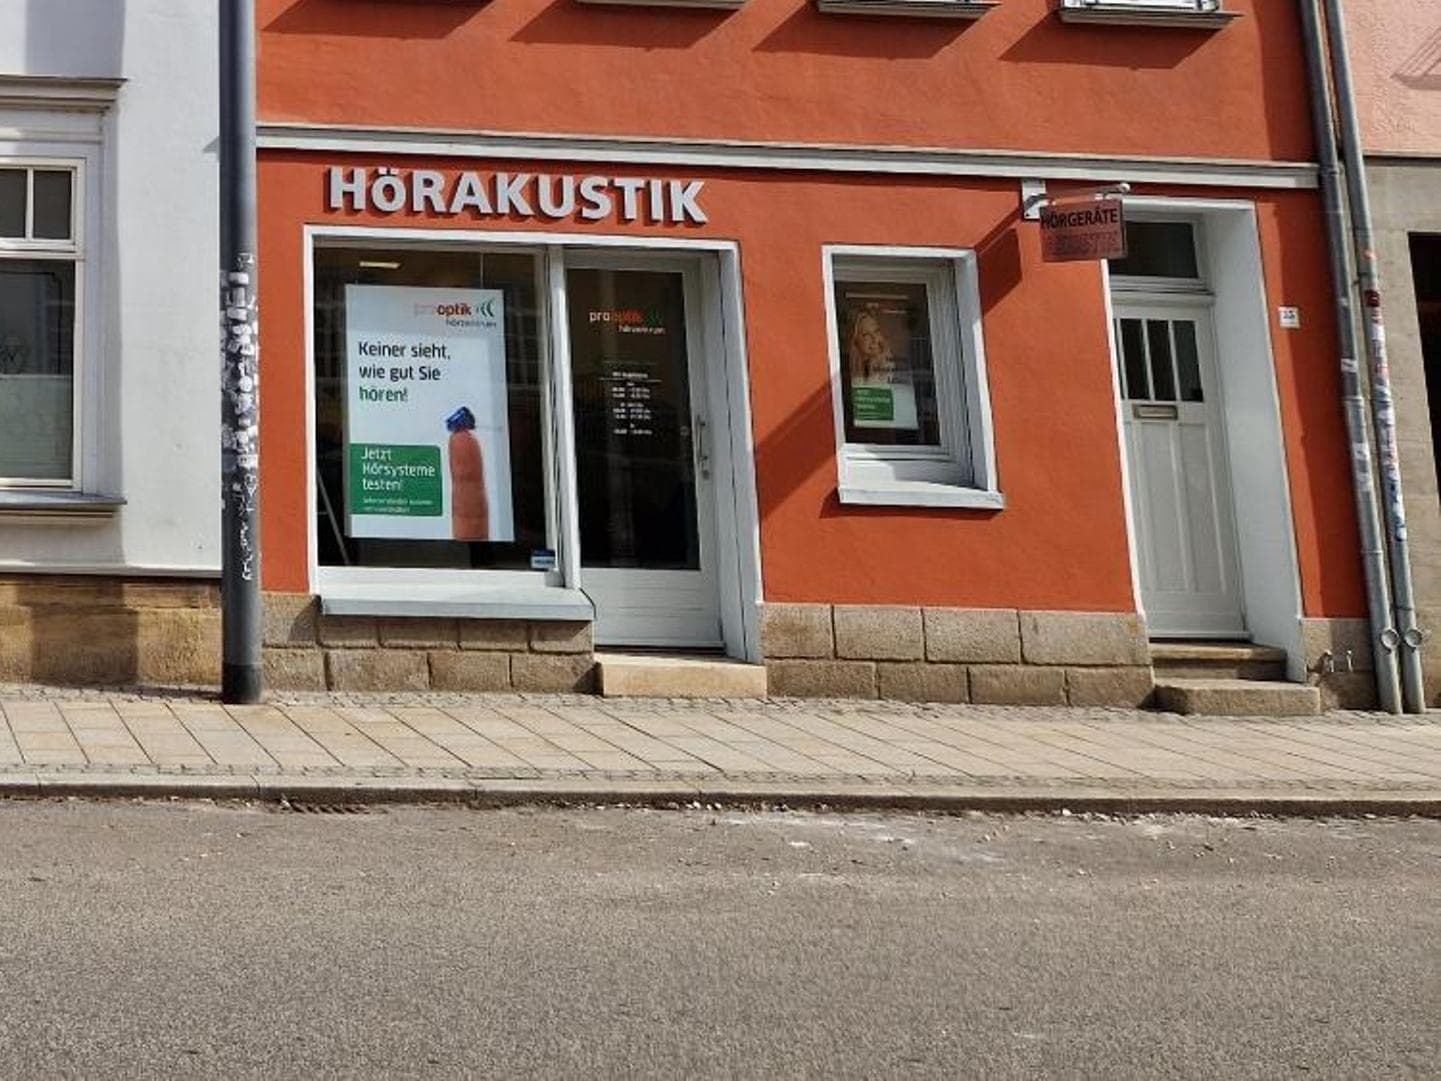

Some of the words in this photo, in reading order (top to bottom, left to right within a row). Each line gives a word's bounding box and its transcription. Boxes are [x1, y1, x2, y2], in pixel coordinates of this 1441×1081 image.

[328, 165, 708, 224] HÖRAKUSTIK
[358, 341, 407, 358] Keiner
[358, 364, 386, 379] wie
[390, 366, 414, 382] gut
[419, 366, 441, 380] Sie
[361, 447, 392, 460] Jetzt
[362, 462, 435, 477] Hörsysteme
